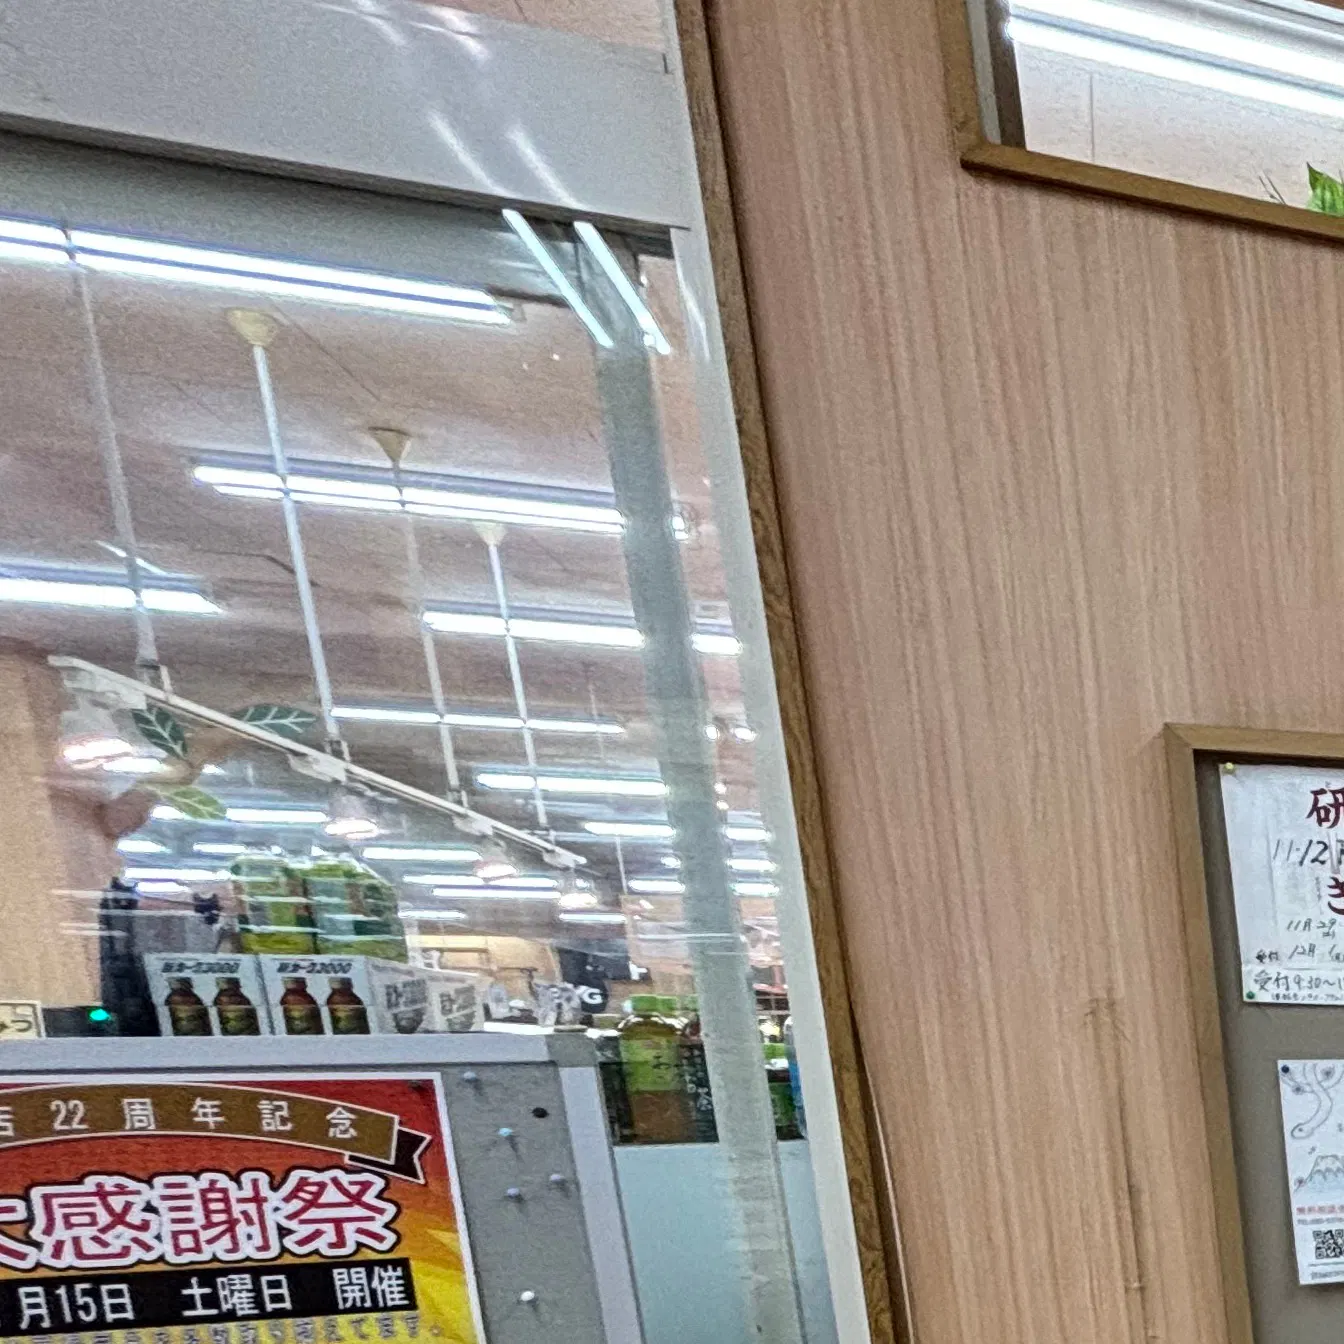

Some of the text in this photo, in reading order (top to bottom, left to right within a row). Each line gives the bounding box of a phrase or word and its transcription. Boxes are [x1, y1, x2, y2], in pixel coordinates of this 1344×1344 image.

[180, 1272, 293, 1319] 土曜日
[331, 1263, 411, 1311] 開催
